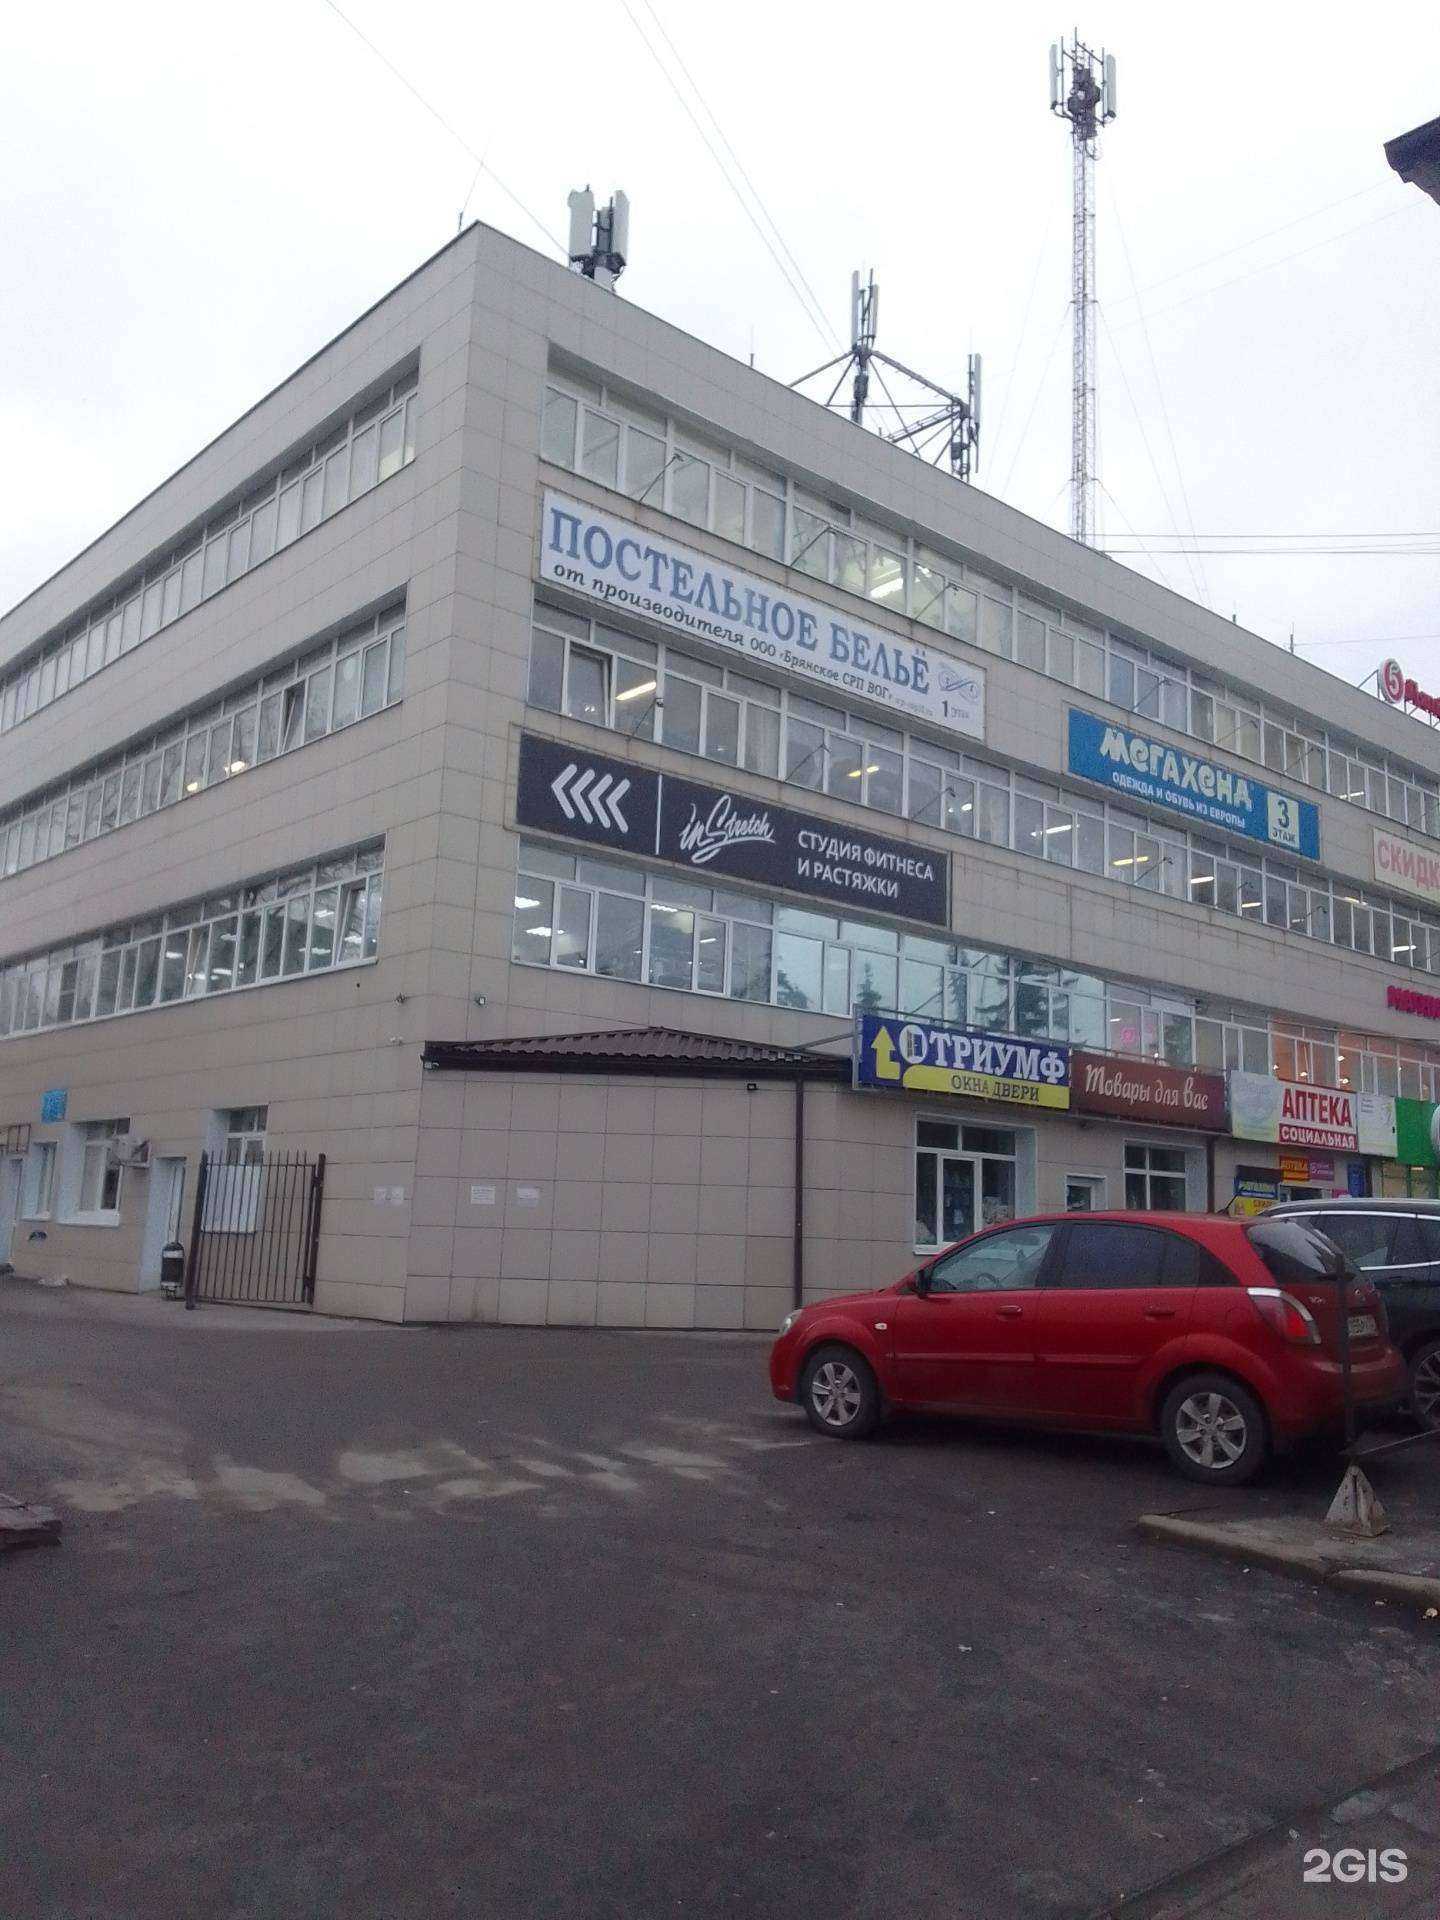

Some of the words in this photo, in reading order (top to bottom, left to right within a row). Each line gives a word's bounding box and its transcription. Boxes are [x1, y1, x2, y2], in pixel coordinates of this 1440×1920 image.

[549, 507, 819, 651] ПОСТЕЛЬНОЕ
[829, 622, 930, 696] БЕЛЬЁ
[553, 563, 586, 586] от
[592, 577, 745, 647] производителя
[750, 636, 777, 657] ООО
[942, 700, 949, 718] 1
[1112, 771, 1154, 796] ОДЕЖДА
[1156, 787, 1163, 799] И
[1165, 790, 1195, 811] ОБУВЬ
[1196, 801, 1208, 815] ИЗ
[1209, 806, 1246, 828] ЕВРОПЫ
[1277, 799, 1291, 829] 3
[798, 829, 860, 861] СТУДИЯ
[863, 847, 934, 881] ФИТНЕСА
[1271, 829, 1297, 842] ЭТАЖ
[797, 858, 810, 877] И
[813, 861, 899, 898] РАСТЯЖКИ
[951, 1075, 989, 1095] ОКНА
[992, 1081, 1039, 1102] ДВЕРИ
[1086, 1063, 1151, 1106] Товары
[1155, 1079, 1178, 1106] для
[1282, 1088, 1352, 1128] АПТЕКА
[1281, 1126, 1355, 1149] СОЦИАЛЬНАЯ
